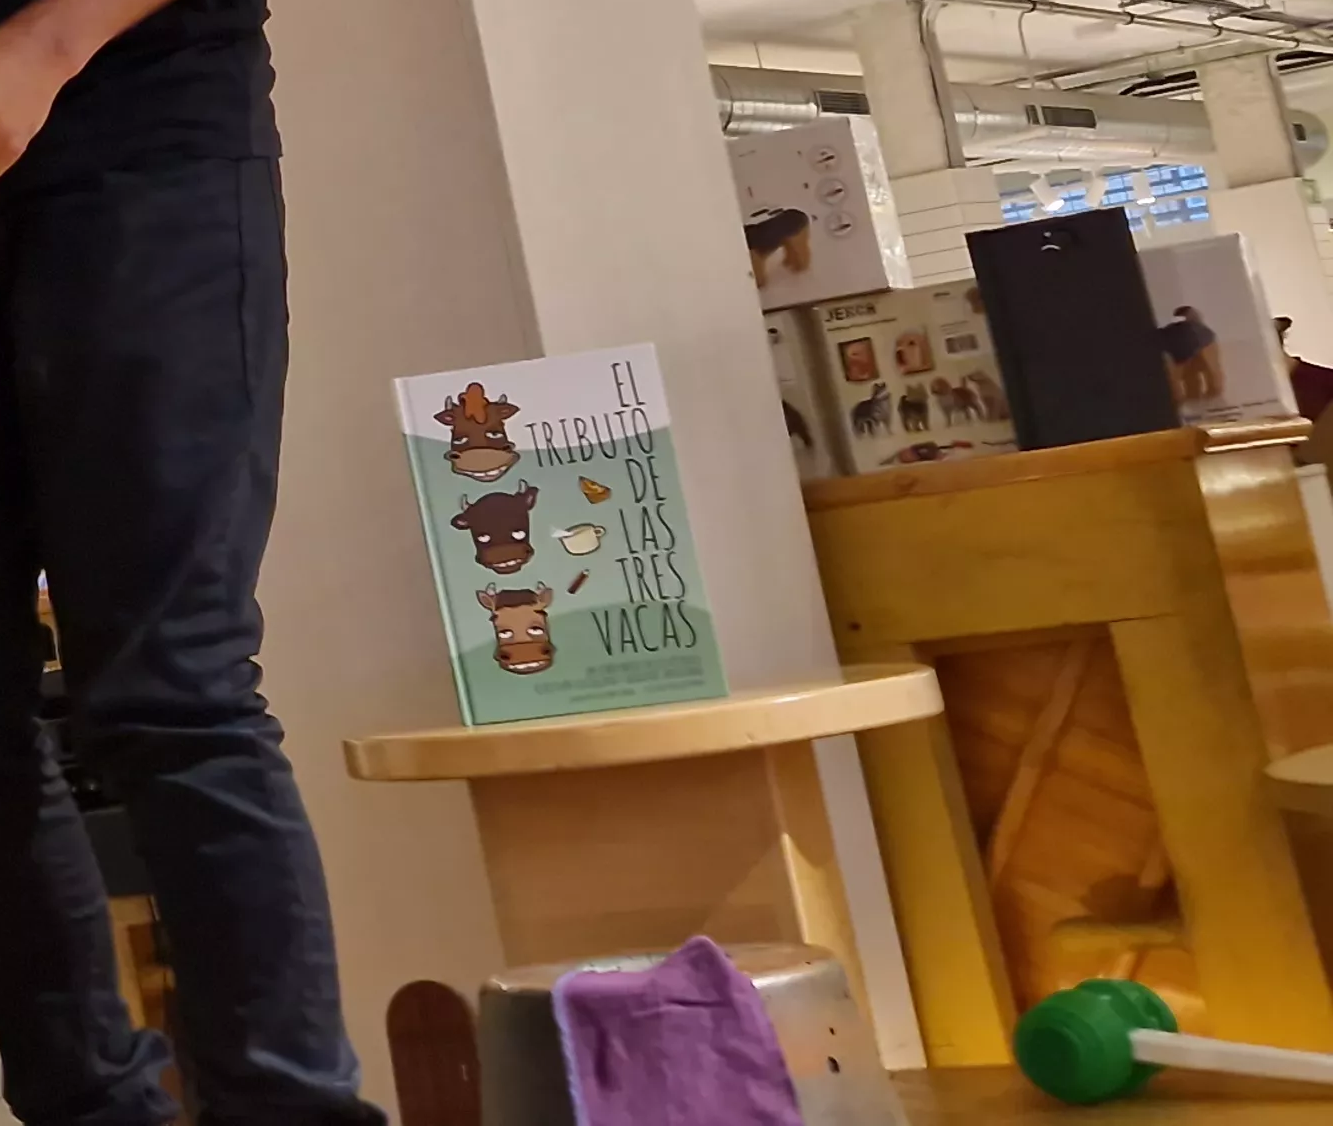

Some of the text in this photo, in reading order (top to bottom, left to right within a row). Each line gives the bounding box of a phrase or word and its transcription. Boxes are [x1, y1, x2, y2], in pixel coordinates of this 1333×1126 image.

[611, 361, 647, 408] EL
[525, 408, 655, 468] TRIBUTO
[626, 456, 667, 504] DE
[619, 503, 676, 554] LAS
[615, 552, 686, 603] TRES
[592, 601, 698, 657] VACAS
